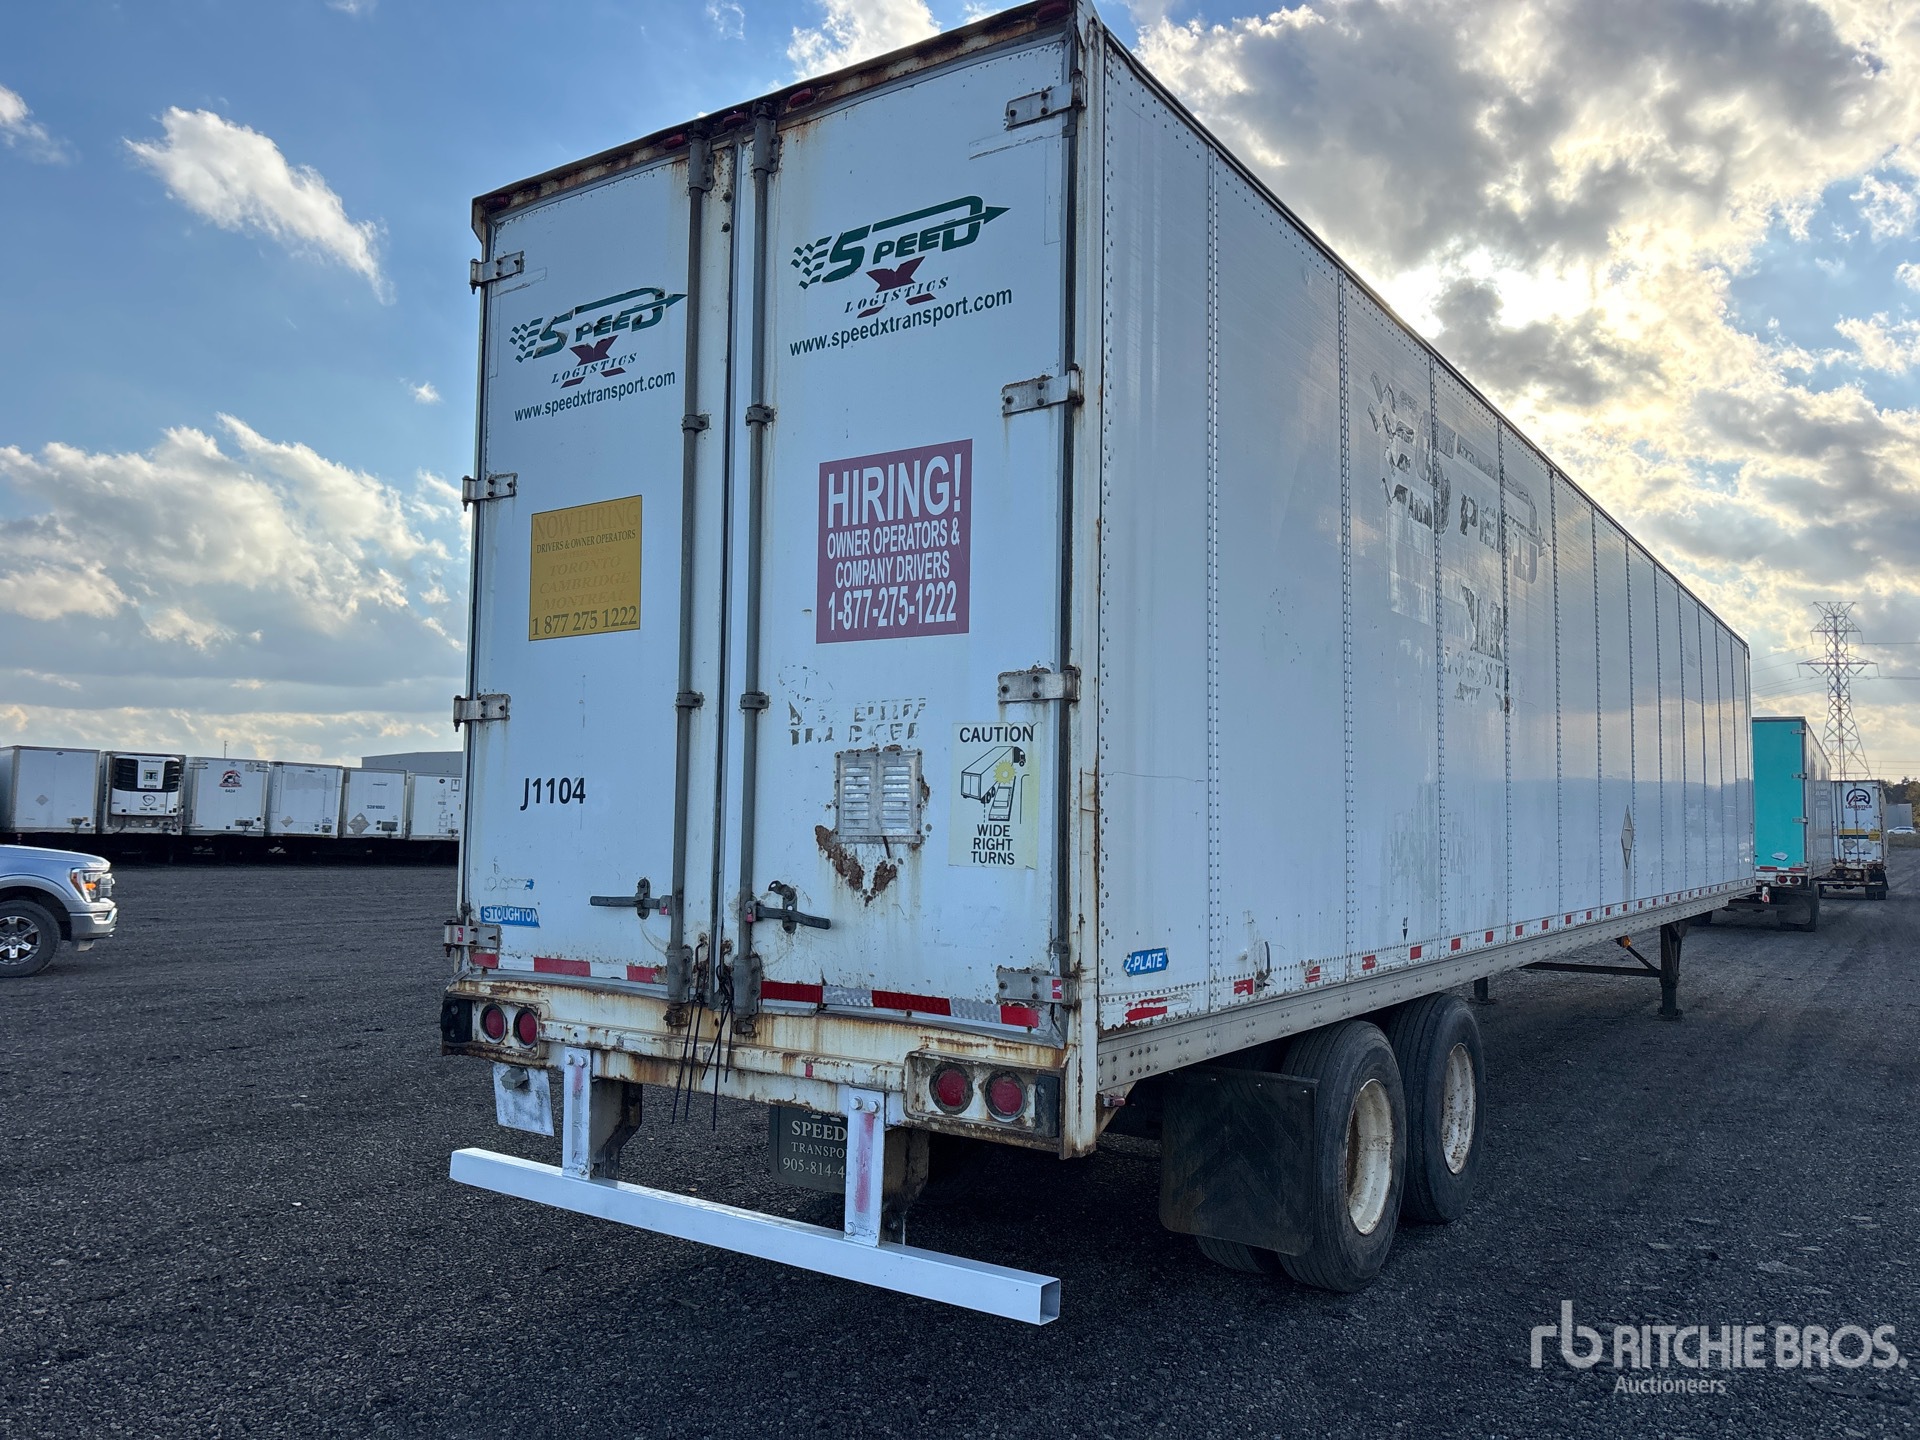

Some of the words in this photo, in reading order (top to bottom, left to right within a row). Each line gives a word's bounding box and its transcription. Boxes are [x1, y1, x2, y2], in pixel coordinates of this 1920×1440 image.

[844, 276, 949, 313] LOGISTICS
[789, 289, 1012, 356] www.speedxtransport.com
[551, 352, 638, 384] LOGISTICS
[514, 371, 676, 422] www.speedxtransport.com
[827, 453, 962, 529] HIRING!
[577, 501, 640, 535] HIRING
[536, 540, 563, 554] DRIVERS
[564, 539, 570, 549] &
[571, 536, 595, 549] OWNER
[596, 529, 636, 545] OPERATORS
[827, 528, 871, 559] OWNER
[873, 518, 948, 555] OPERATORS
[951, 517, 961, 546] &
[835, 556, 894, 588] COMPANY
[896, 550, 950, 583] DRIVERS
[532, 617, 540, 636] 1
[544, 613, 569, 634] 877
[573, 610, 598, 631] 275
[602, 605, 637, 628] 1222
[828, 580, 957, 631] 1-877-275-1222
[959, 726, 1034, 743] CAUTION
[520, 777, 586, 811] J1104
[973, 838, 1013, 851] RIGHT
[977, 823, 1010, 838] WIDE
[971, 851, 1015, 865] TURNS
[484, 906, 539, 923] STOUGHTON
[1125, 952, 1164, 973] Z-PLATE
[791, 1120, 848, 1142] SPEED
[791, 1142, 848, 1160] TRANSPO
